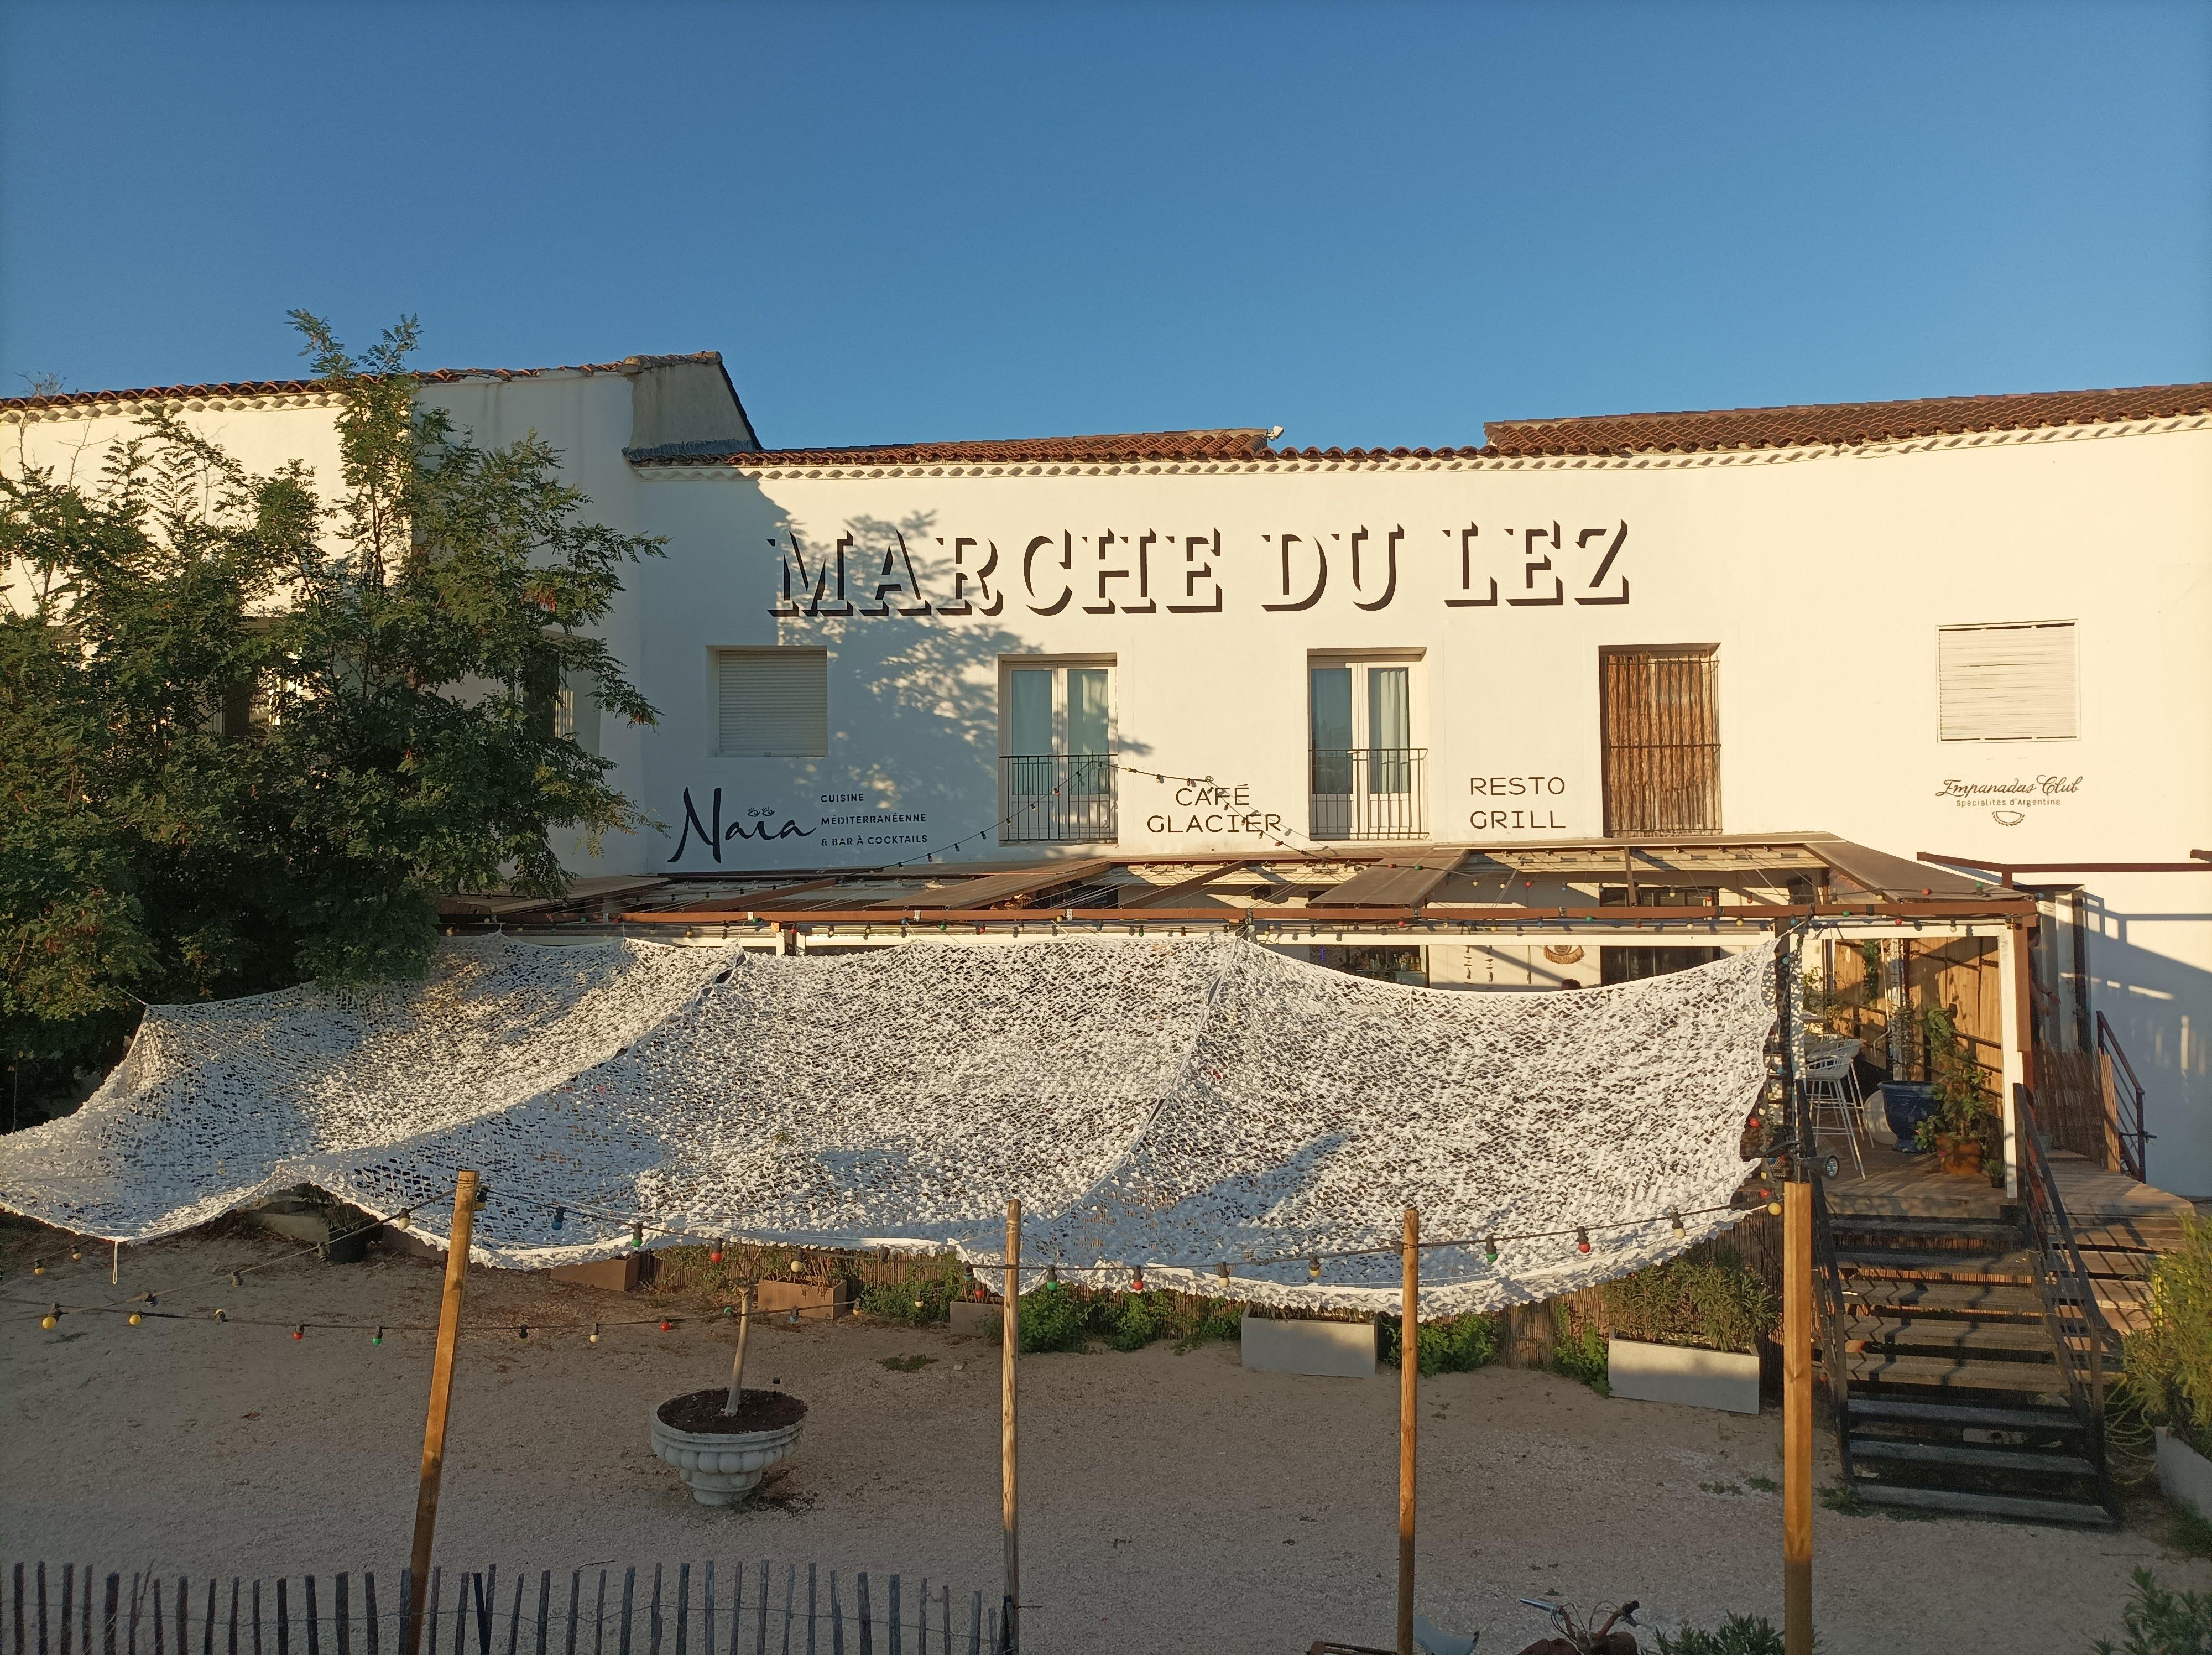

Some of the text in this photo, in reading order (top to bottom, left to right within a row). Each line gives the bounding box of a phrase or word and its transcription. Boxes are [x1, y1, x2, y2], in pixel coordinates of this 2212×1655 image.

[766, 519, 1629, 617] MARCHE DU LEZ
[1175, 784, 1250, 806] CAFÉ
[1470, 777, 1565, 795] RESTO
[1935, 774, 2083, 798] Empanadas Club
[821, 793, 864, 803] CUISINE
[1956, 798, 2061, 808] Spécialités d'Argentine
[821, 813, 927, 825] MÉDITERRANÉENNE
[1147, 814, 1281, 833] GLACIER
[1470, 810, 1566, 829] GRILL
[821, 834, 928, 846] & BAR À COCKTAILS
